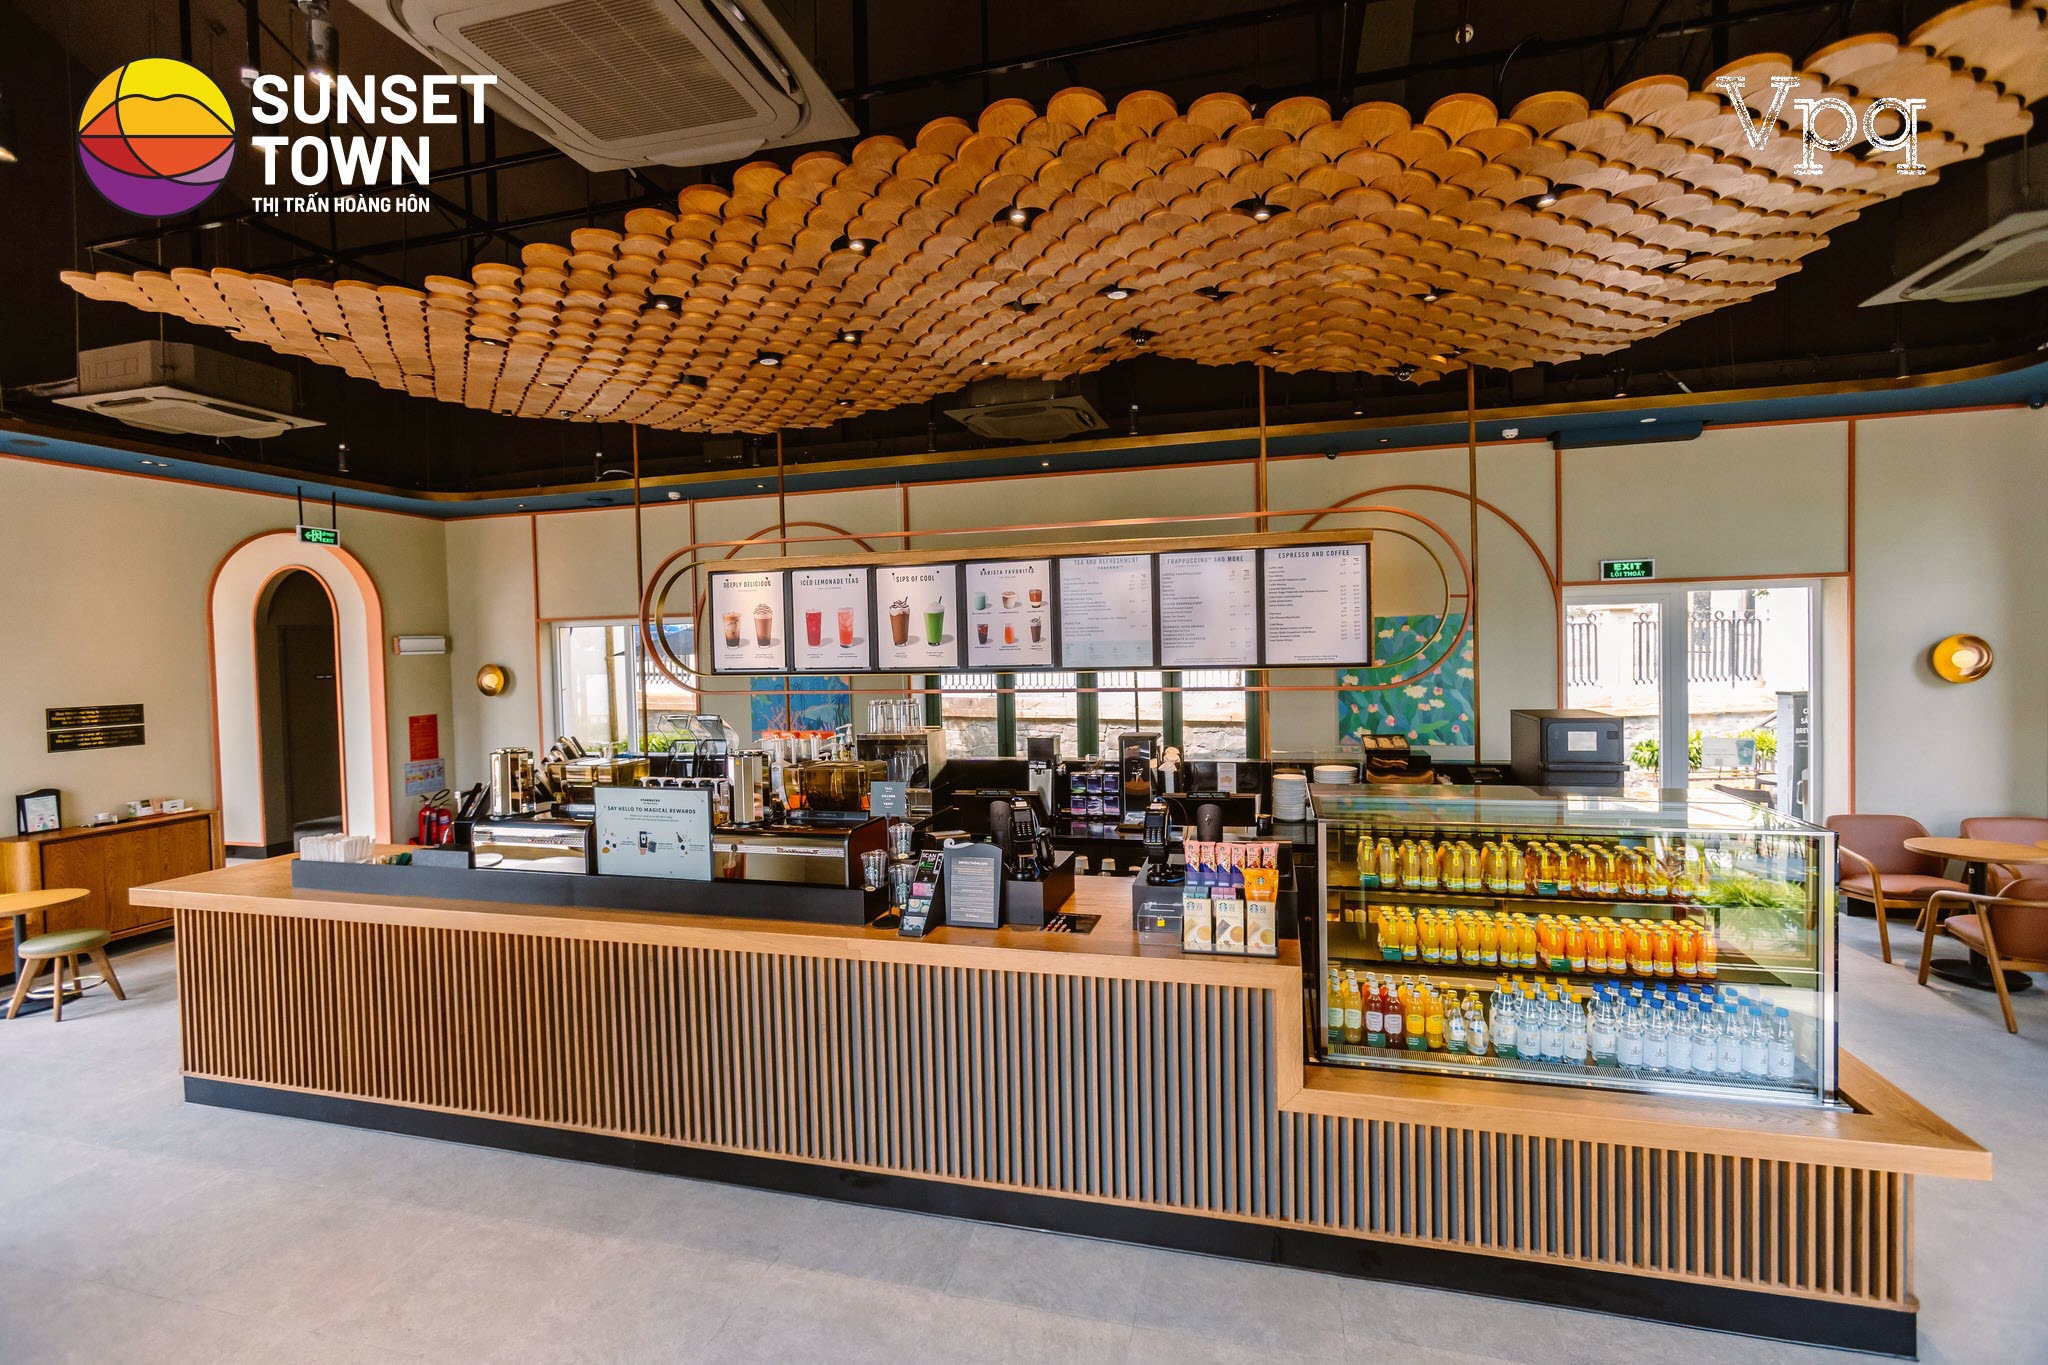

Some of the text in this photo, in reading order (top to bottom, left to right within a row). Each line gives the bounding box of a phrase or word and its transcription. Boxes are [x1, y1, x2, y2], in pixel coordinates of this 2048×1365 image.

[1278, 551, 1310, 559] ESPRESSO
[1326, 549, 1350, 557] COFFEE
[1098, 557, 1139, 565] REFRESHMENT
[1613, 562, 1643, 571] EXIT
[979, 567, 1035, 576] BARISTA FAVORITES
[895, 575, 910, 583] SIPS
[919, 574, 935, 582] COOL
[723, 579, 772, 589] DEEPLY DELICIOUS
